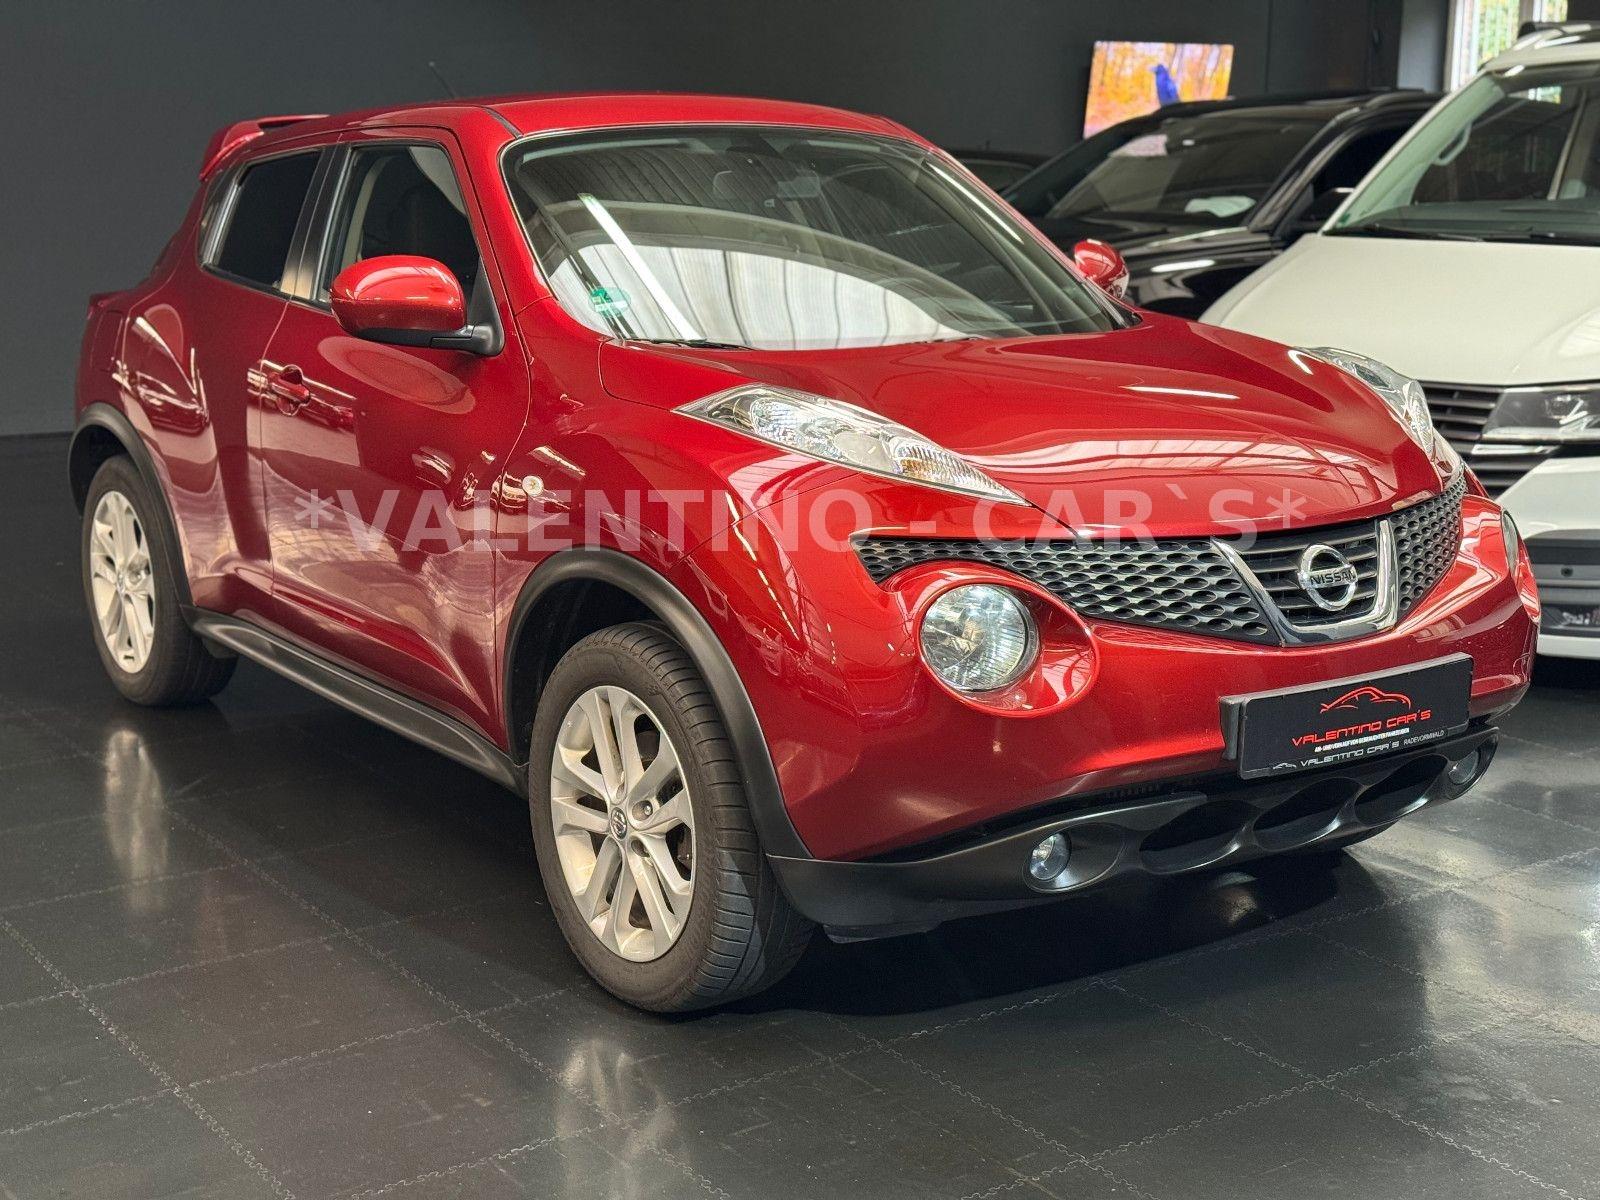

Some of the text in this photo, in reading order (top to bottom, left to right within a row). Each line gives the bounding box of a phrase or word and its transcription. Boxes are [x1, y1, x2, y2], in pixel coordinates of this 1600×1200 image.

[1310, 569, 1355, 585] NISSAN
[1291, 721, 1382, 747] VALENTINO
[1300, 748, 1364, 767] VALENTINO
